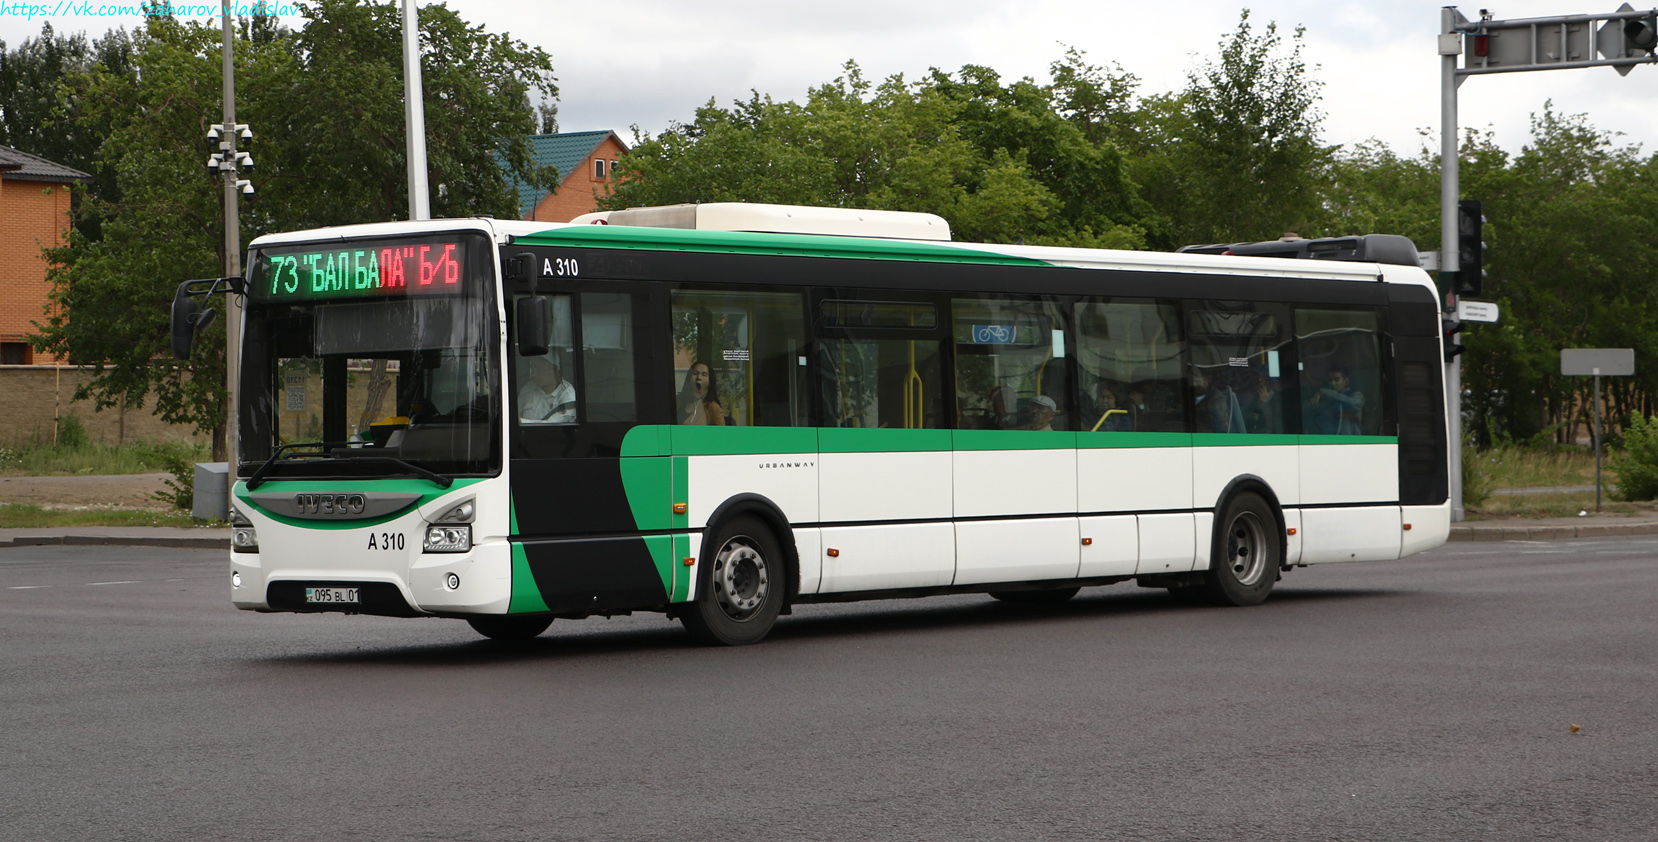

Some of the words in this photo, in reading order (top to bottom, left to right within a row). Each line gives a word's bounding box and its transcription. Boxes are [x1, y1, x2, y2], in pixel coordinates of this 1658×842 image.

[270, 255, 299, 294] 73
[419, 244, 460, 286] Б/Б
[543, 257, 554, 276] A
[555, 257, 579, 277] 310
[758, 461, 815, 469] URBANWAY
[297, 493, 365, 514] IVECO
[367, 532, 378, 550] A
[381, 532, 405, 551] 310
[314, 588, 332, 602] 095
[334, 591, 346, 602] BL
[348, 588, 360, 602] 01
